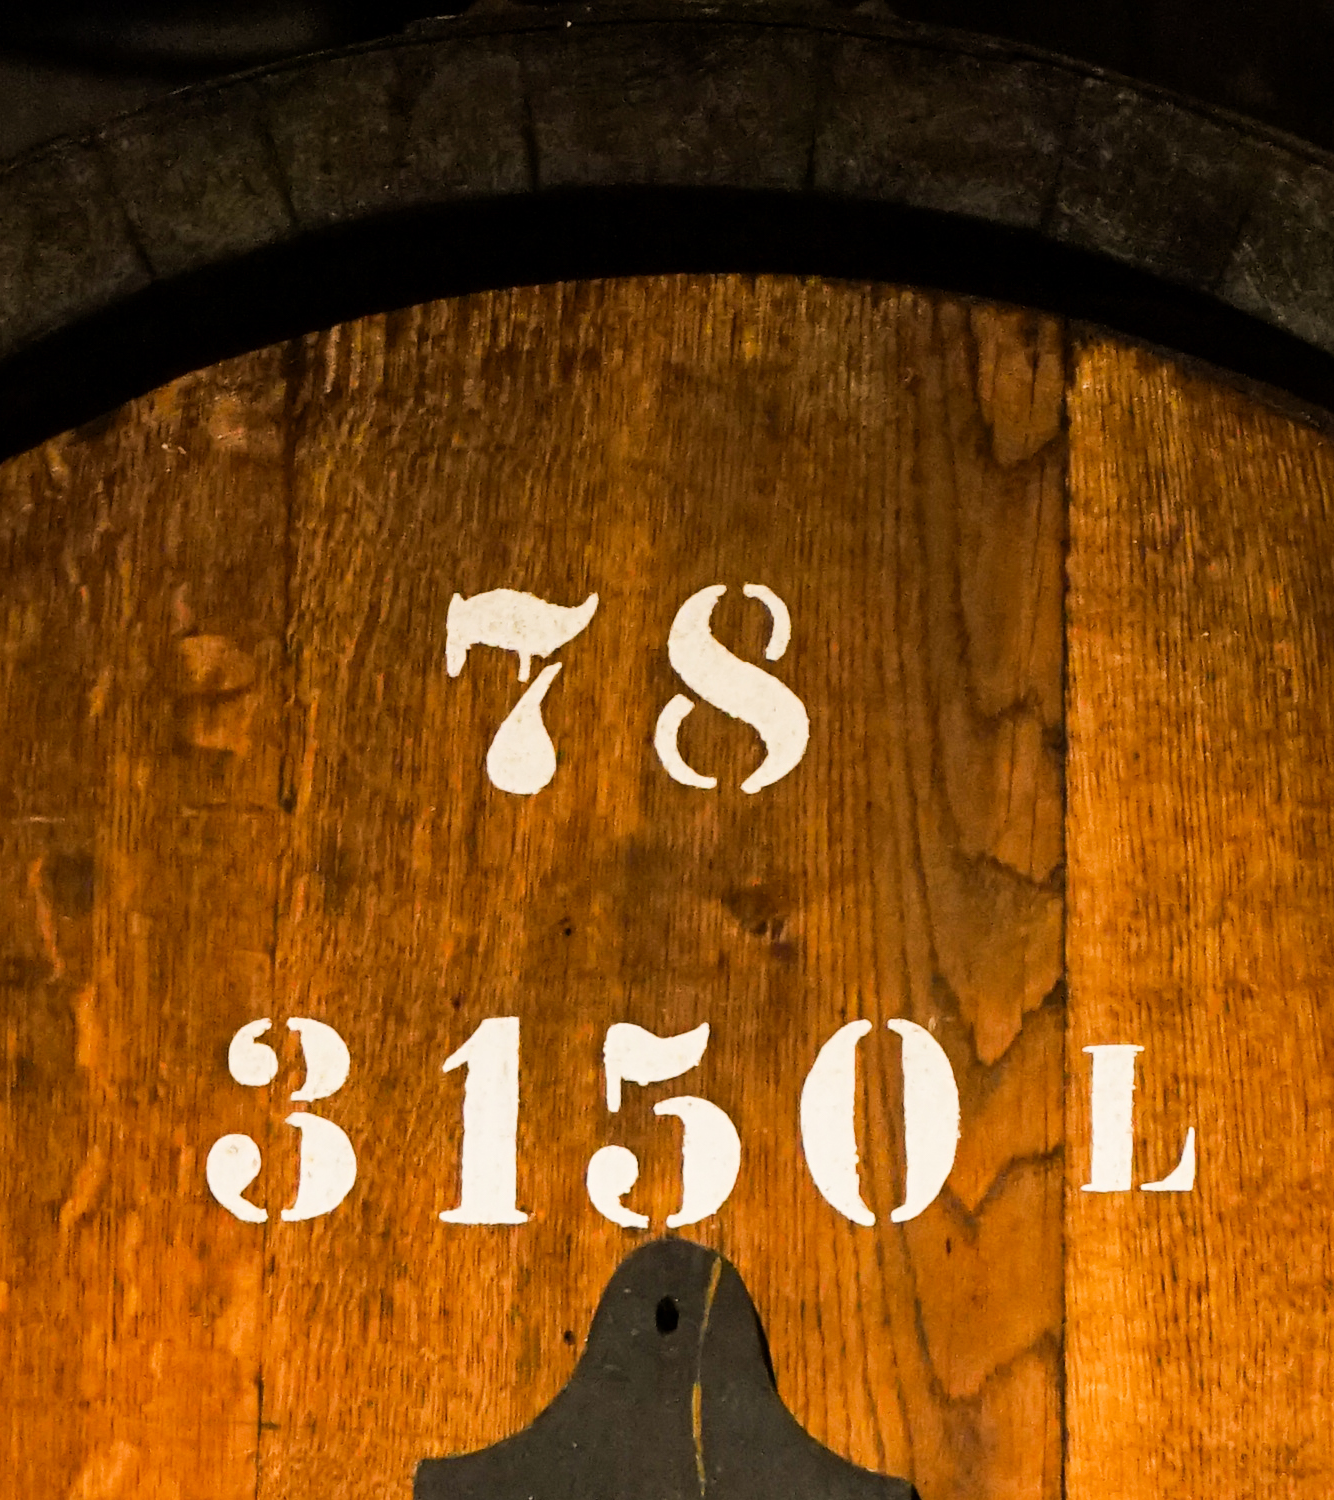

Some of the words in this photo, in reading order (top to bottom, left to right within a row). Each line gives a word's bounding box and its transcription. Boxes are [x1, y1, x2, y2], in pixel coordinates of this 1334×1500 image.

[445, 583, 810, 795] 78
[205, 1016, 961, 1229] 3150
[1082, 1044, 1195, 1192] L
